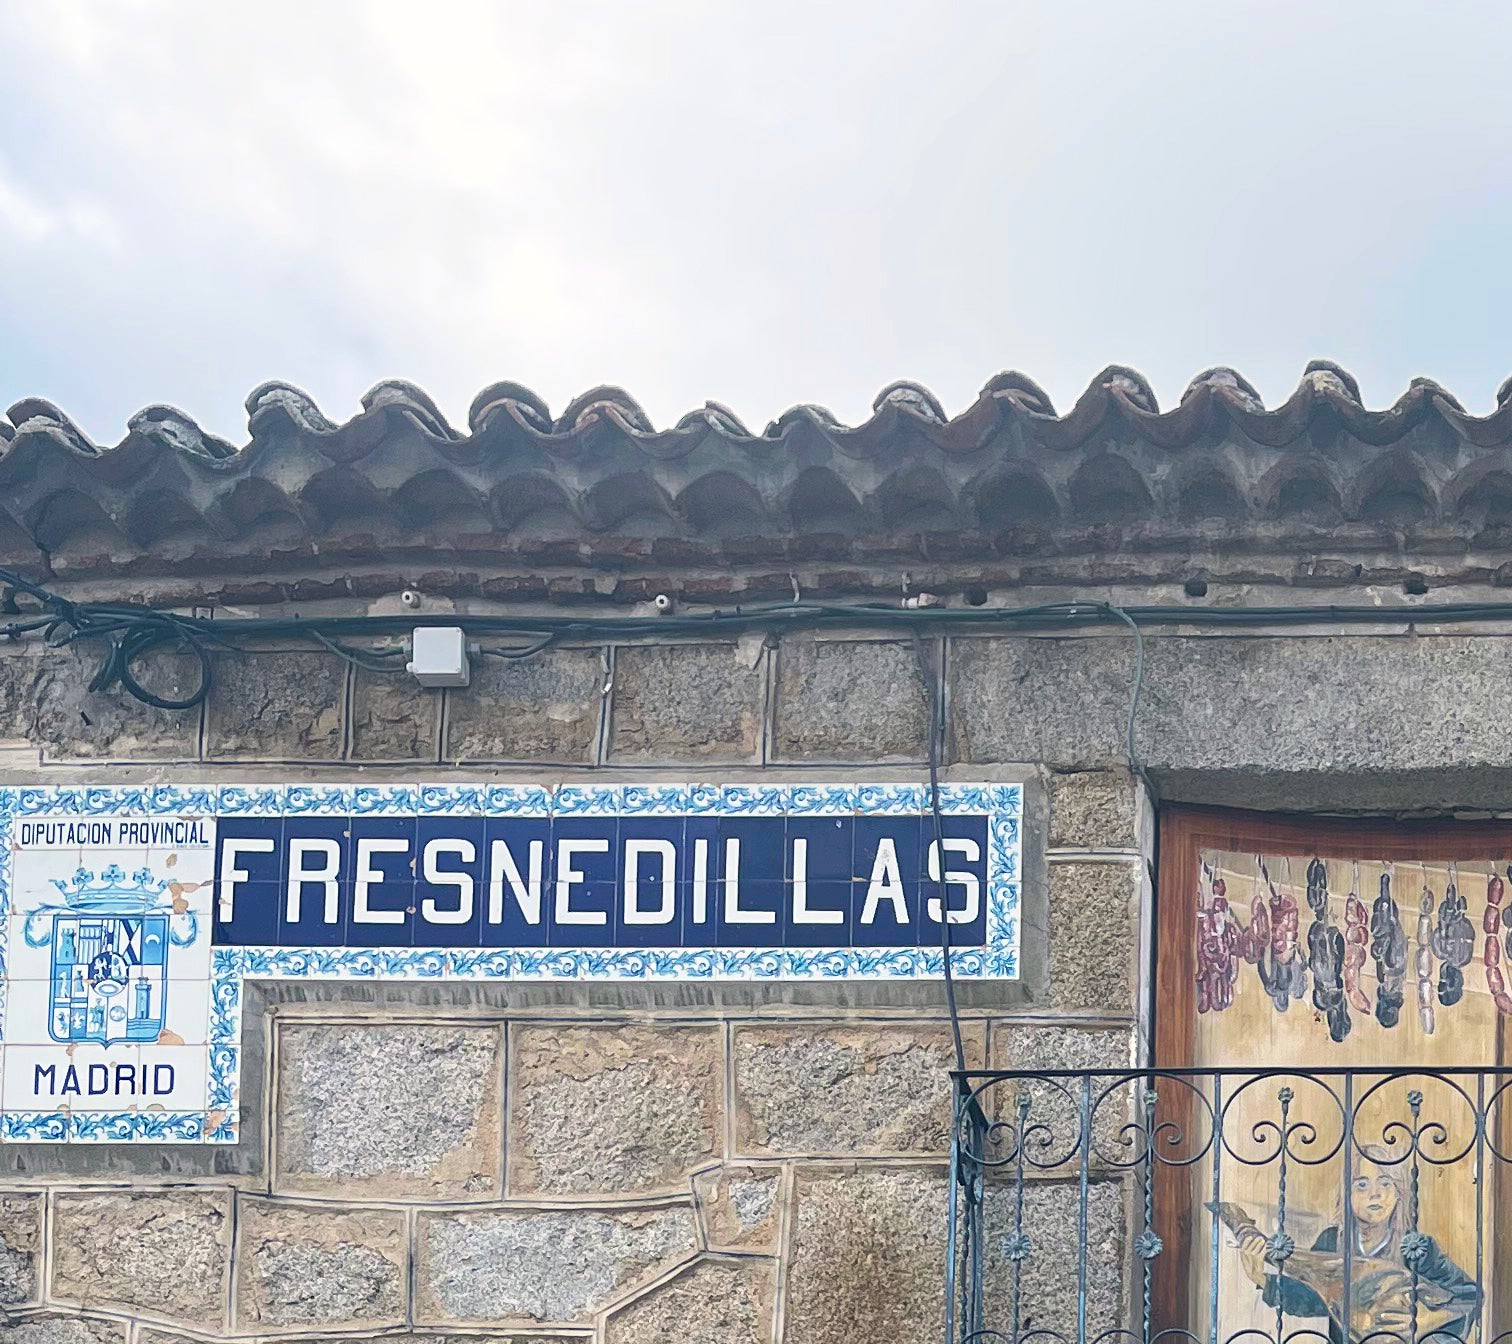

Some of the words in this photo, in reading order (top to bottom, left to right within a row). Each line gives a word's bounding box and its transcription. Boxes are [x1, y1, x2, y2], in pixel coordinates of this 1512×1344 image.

[21, 822, 112, 845] DIPUTACION
[119, 821, 209, 845] PROVINCIAL
[219, 838, 980, 924] FRESNEDILLAS
[34, 1064, 175, 1095] MADRID
